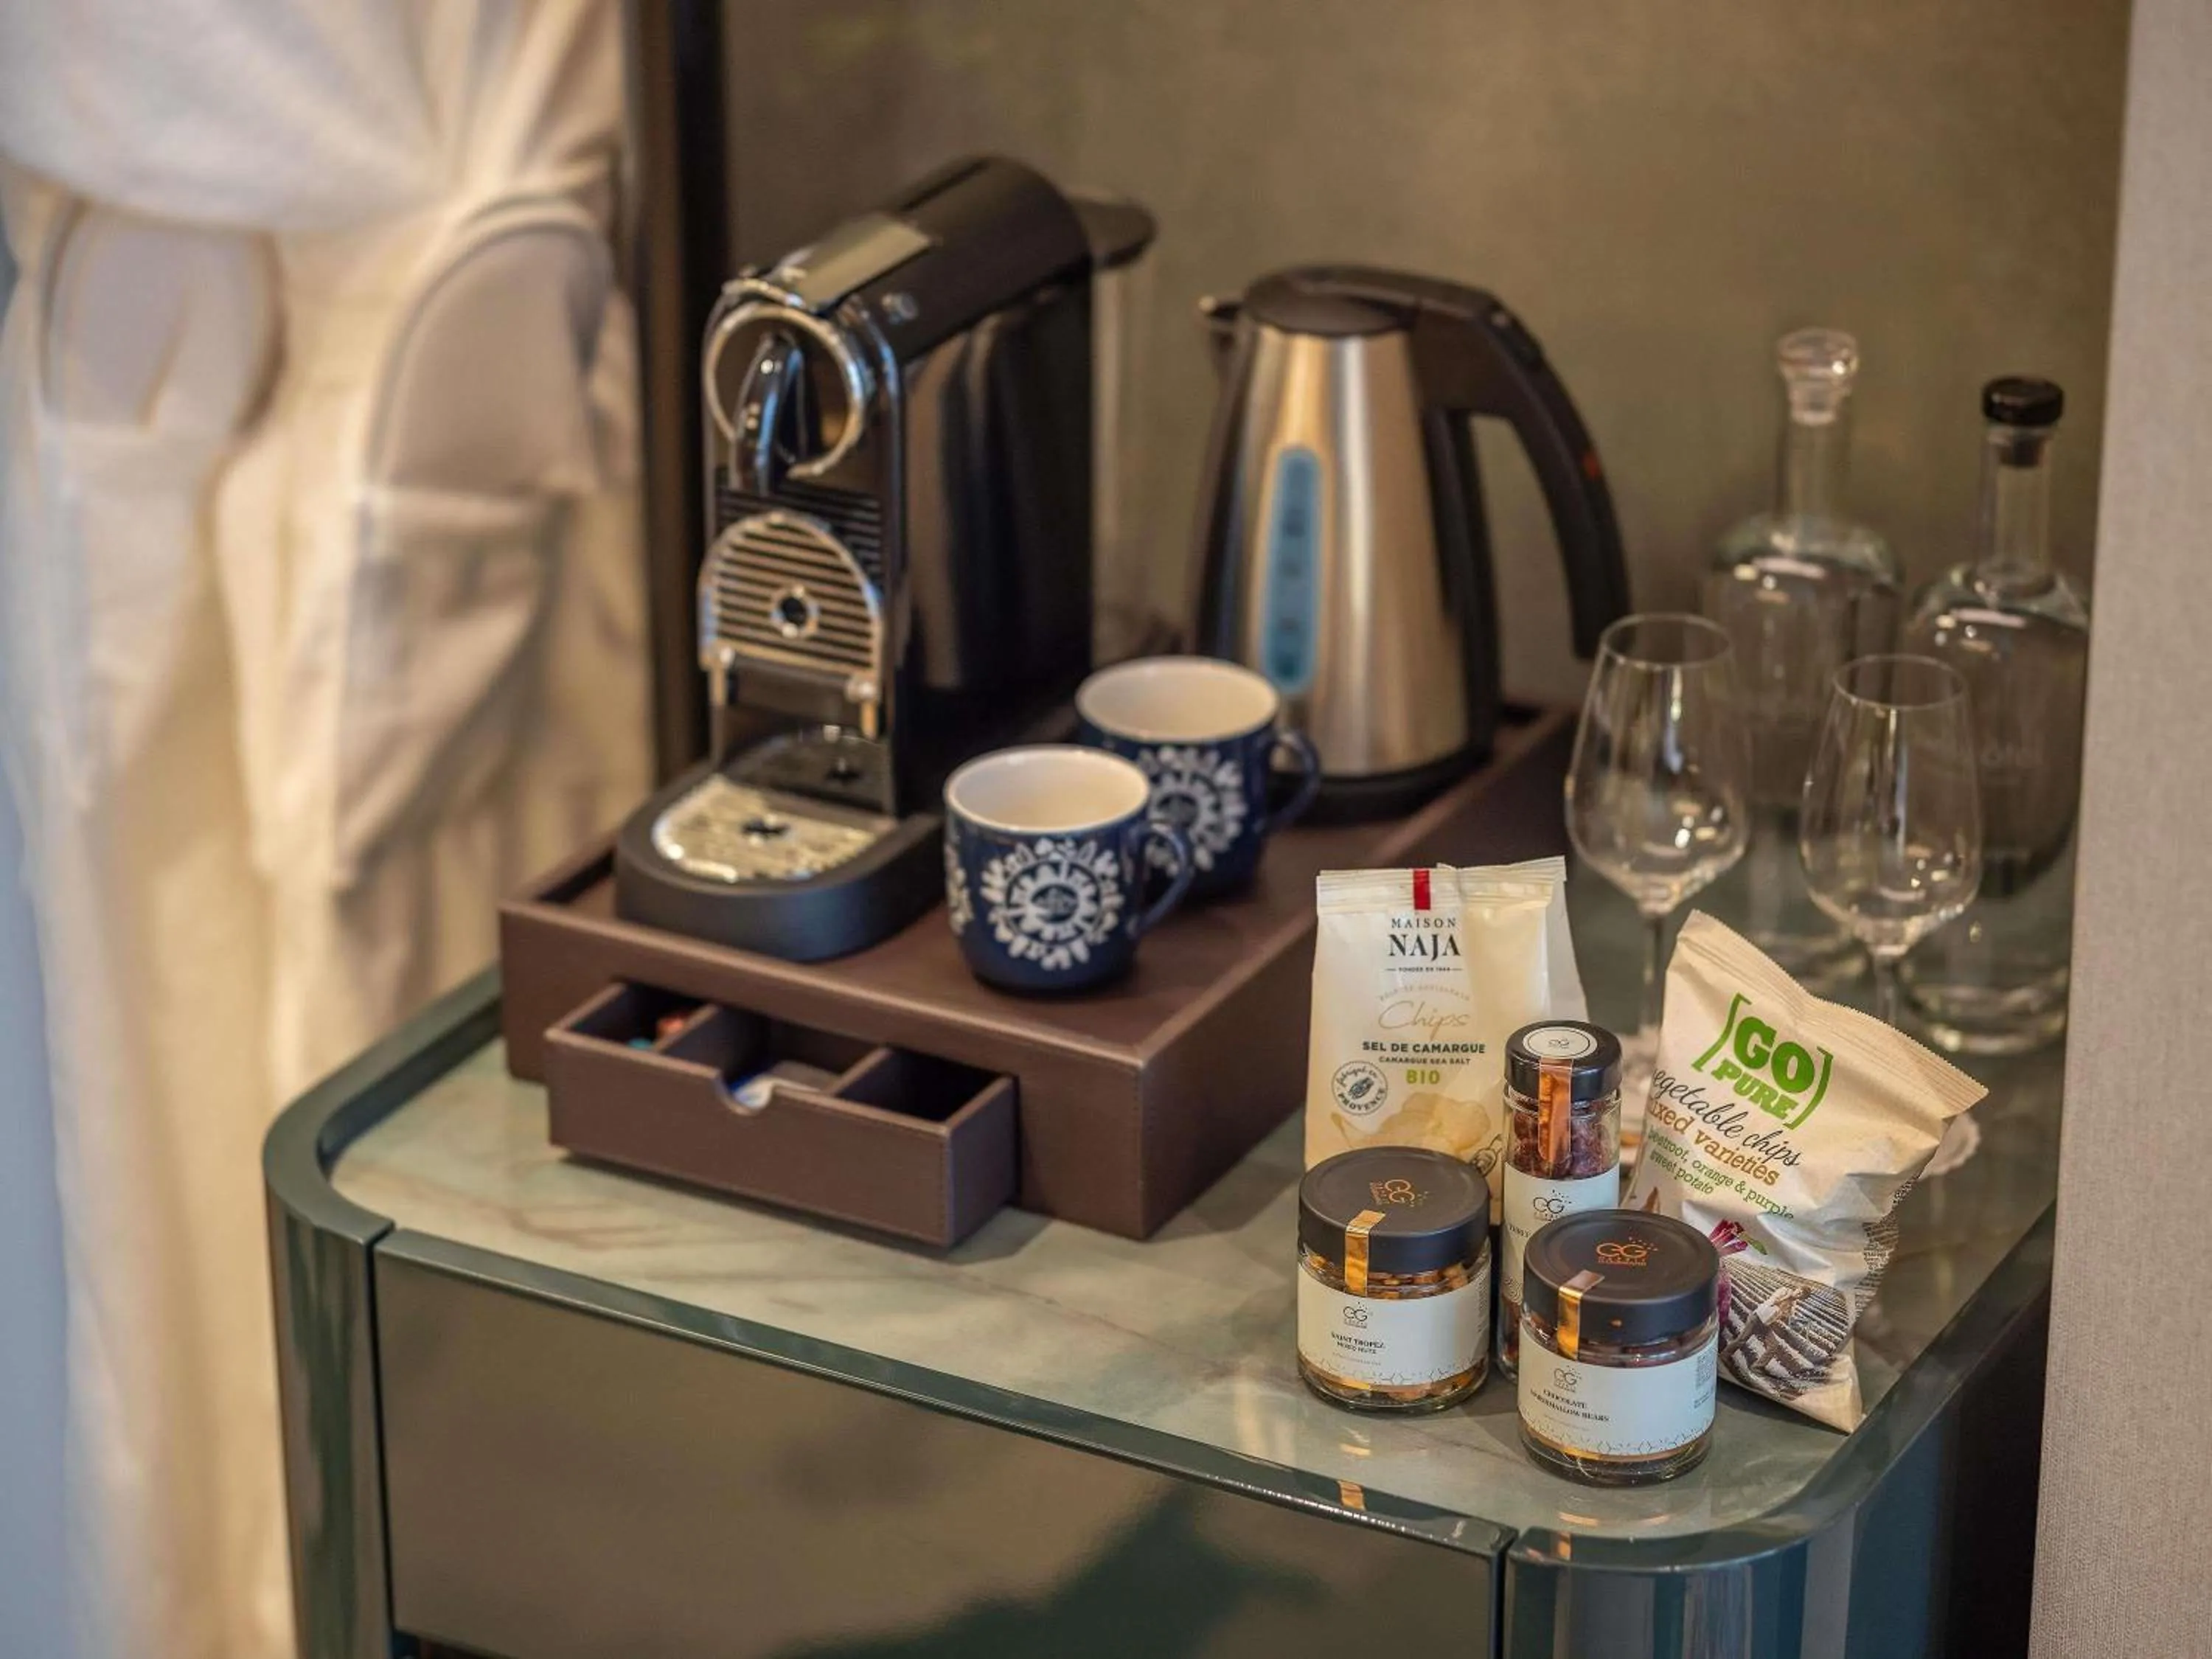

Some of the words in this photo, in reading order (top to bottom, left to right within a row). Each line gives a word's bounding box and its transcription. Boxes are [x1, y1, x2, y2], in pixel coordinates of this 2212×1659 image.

[1391, 917, 1456, 928] MAISON
[1388, 933, 1461, 962] NAJA
[1377, 1000, 1471, 1041] Chips
[1363, 1041, 1387, 1051] SEL
[1391, 1043, 1409, 1052] DE
[1412, 1043, 1486, 1054] CAMARGUE
[1379, 1056, 1427, 1065] CAMARGUE
[1430, 1057, 1447, 1065] SEA
[1450, 1057, 1472, 1065] SALT
[1405, 1070, 1441, 1085] BIO
[1710, 1057, 1799, 1120] PURE
[1652, 1069, 1749, 1139] egetable
[1742, 1130, 1802, 1167] chips
[1649, 1149, 1677, 1172] sweet
[1674, 1167, 1715, 1195] potato
[1694, 1128, 1781, 1186] varieties
[1691, 1159, 1733, 1187] orange
[1734, 1180, 1747, 1194] &
